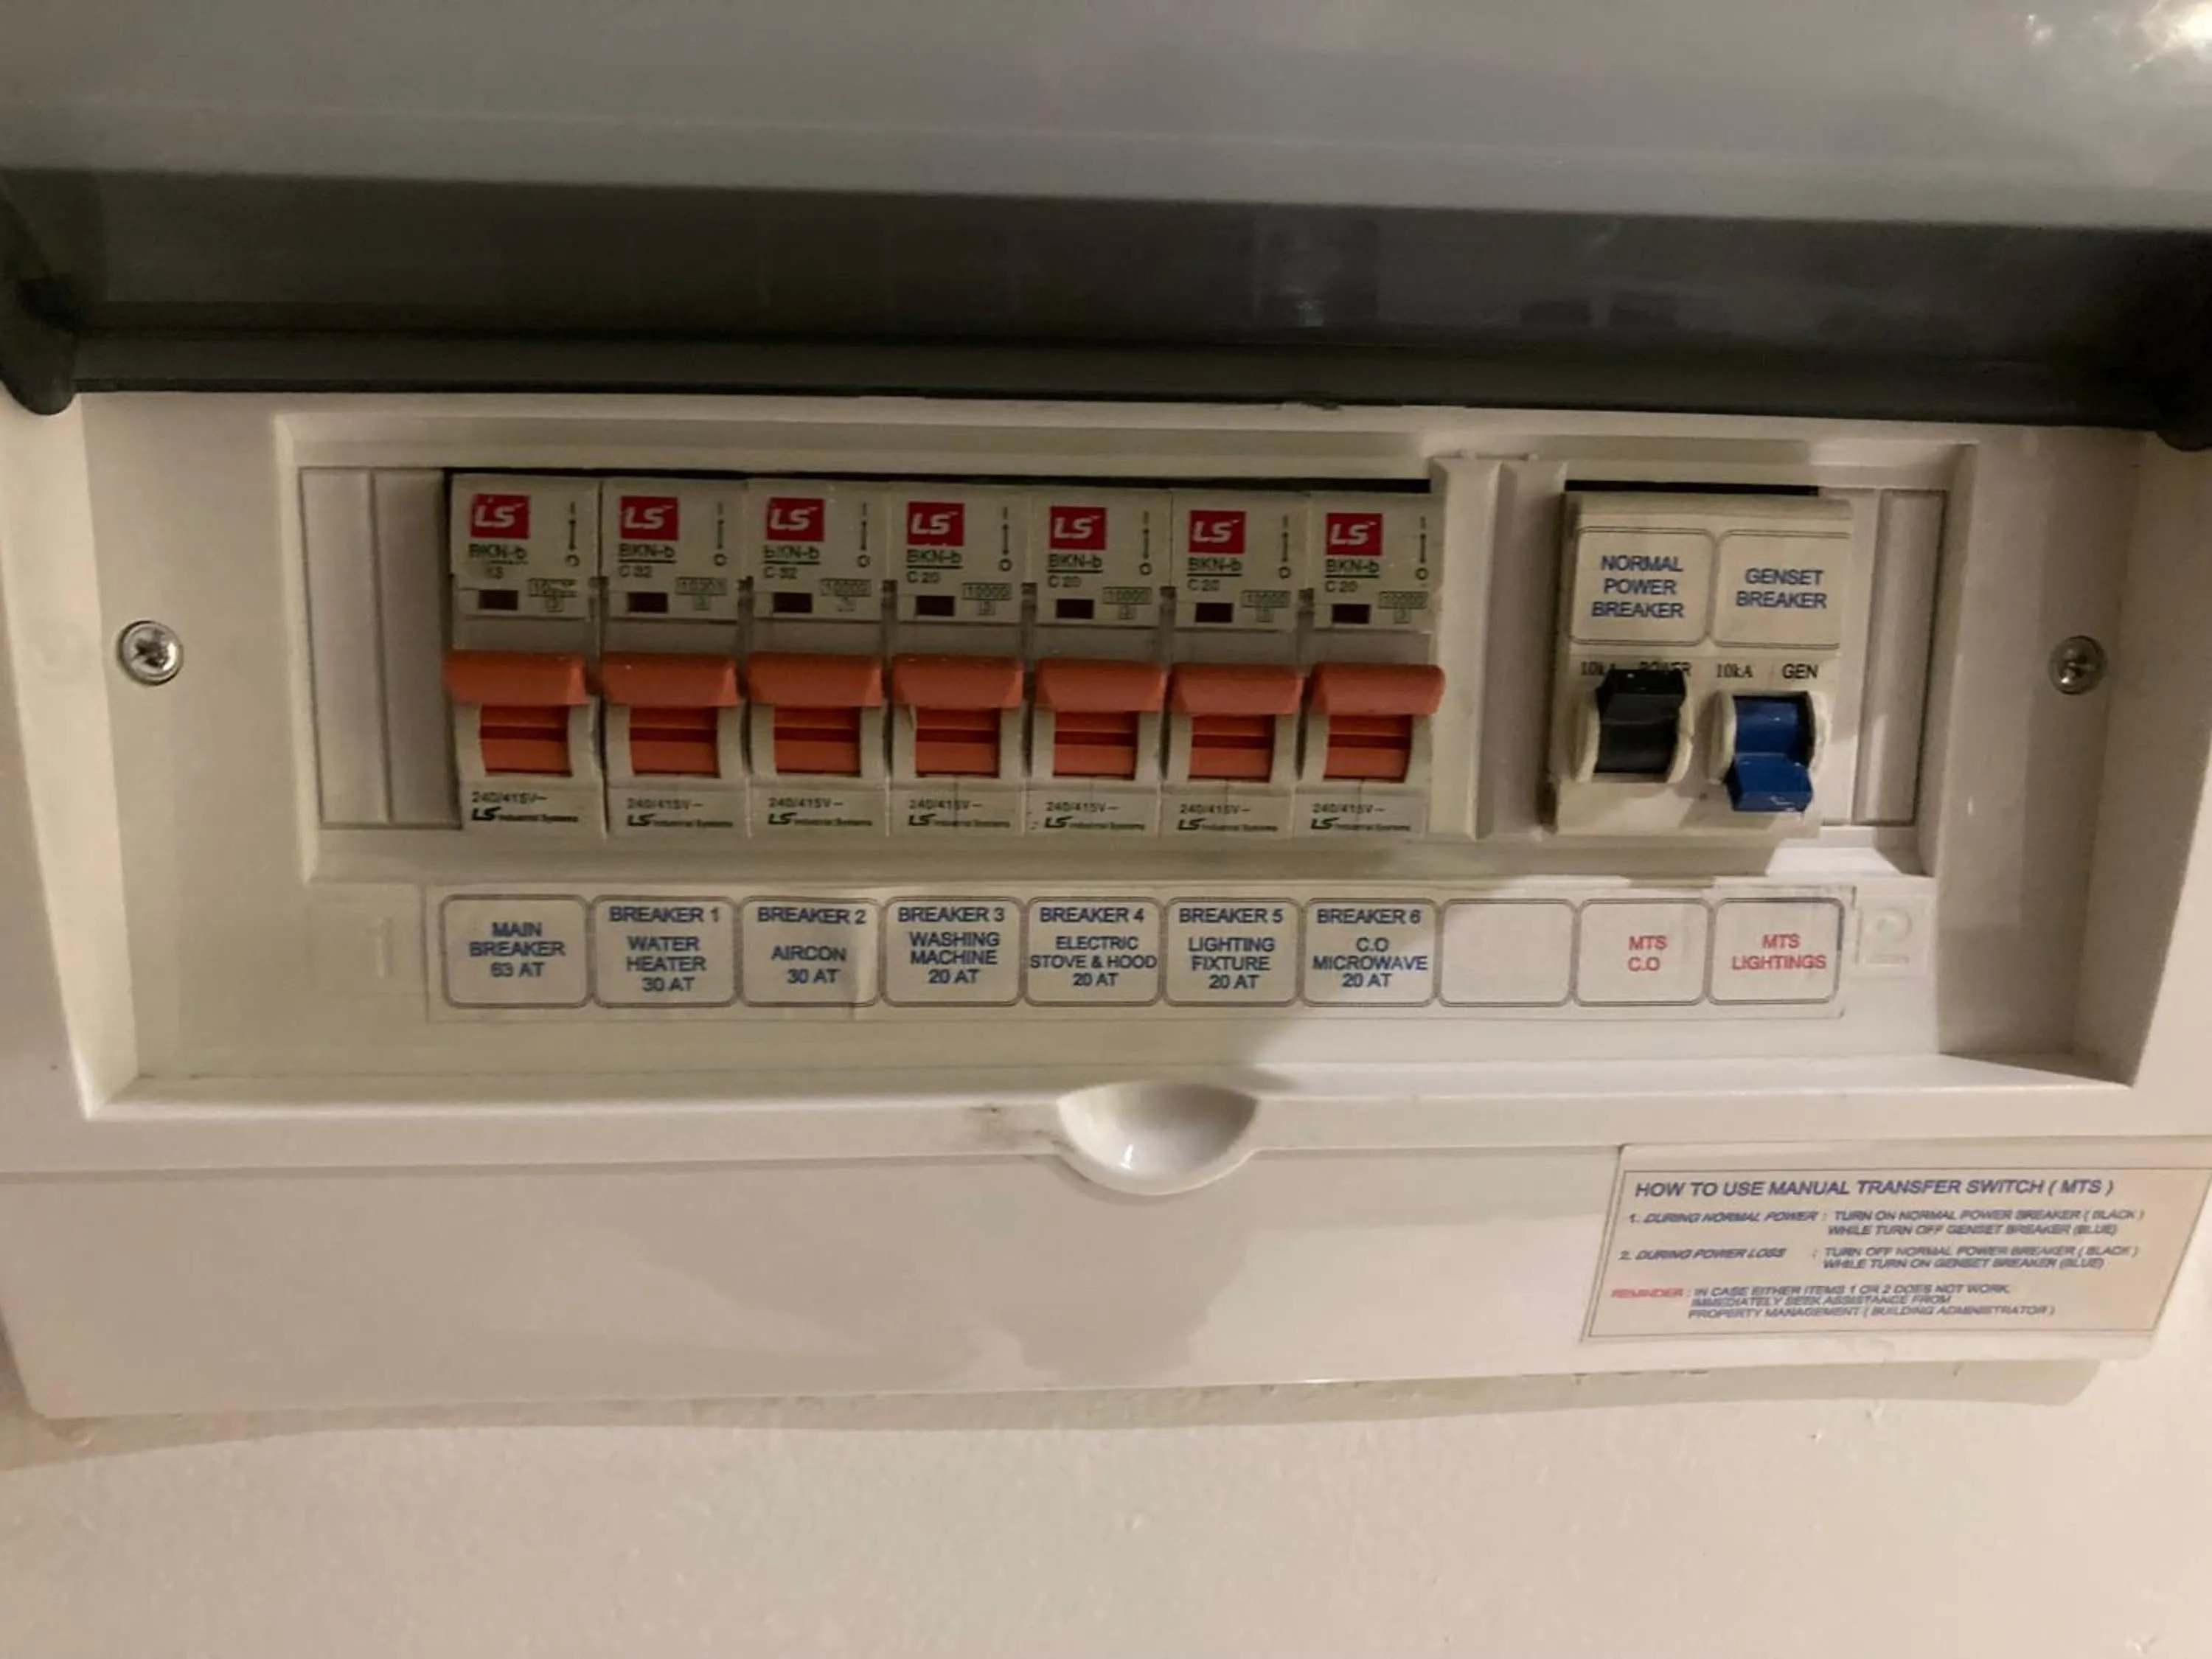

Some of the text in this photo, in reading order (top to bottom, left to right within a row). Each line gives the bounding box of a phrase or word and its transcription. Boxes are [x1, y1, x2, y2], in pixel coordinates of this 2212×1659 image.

[1048, 554, 1102, 568] BKN-b
[1601, 555, 1683, 572] NORMAL
[1746, 568, 1824, 585] GENSET
[1604, 578, 1676, 595] POWER
[1736, 591, 1827, 609] BREAKER
[1592, 601, 1684, 619] BREAKER
[1717, 664, 1818, 678] 10kA GEN
[471, 806, 502, 821] LS
[626, 813, 658, 827] LS
[767, 812, 798, 826] LS
[908, 813, 937, 827] LS
[1044, 815, 1074, 829] LS
[1178, 817, 1206, 830] LS
[1311, 816, 1340, 830] LS
[609, 907, 719, 922] BREAKER 1
[757, 908, 866, 924] BREAKER 2
[898, 907, 1005, 922] BREAKER 3
[1040, 908, 1144, 922] BREAKER 4
[1178, 908, 1283, 923] BREAKER 5
[1317, 909, 1422, 924] BREAKER 6
[493, 922, 541, 937] MAIN
[628, 936, 699, 952] WATER
[909, 931, 1000, 947] WASHING
[1056, 936, 1138, 951] ELECTRIC
[1189, 937, 1275, 953] LIGHTING
[1356, 937, 1389, 952] C.O
[1629, 935, 1667, 950] MTS
[1762, 933, 1800, 949] MTS
[470, 942, 566, 957] BREAKER
[771, 945, 846, 961] AIRCON
[626, 956, 706, 973] HEATER
[911, 950, 997, 965] MACHINE
[1030, 954, 1158, 970] STOVE & HOOD
[1192, 956, 1270, 972] FIXTURE
[1312, 956, 1427, 971] MICROWAVE
[1628, 957, 1660, 971] C.O
[1732, 956, 1826, 970] LIGHTINGS
[491, 962, 545, 978] 63 AT
[787, 969, 840, 984] 30 AT
[928, 969, 979, 984] 20 AT
[642, 977, 695, 992] 30 AT
[1073, 972, 1119, 987] 20 AT
[1208, 974, 1259, 990] 20 AT
[1342, 973, 1392, 988] 20 AT
[1635, 1179, 2101, 1197] HOW TO USE MANUAL TRANSFER SWITCH MTS
[1644, 1212, 1700, 1223] DURING
[1702, 1211, 1759, 1222] NORMAL
[1764, 1211, 1819, 1222] POWER
[1834, 1211, 1873, 1221] TURN
[1899, 1210, 1956, 1221] NORMAL
[1961, 1210, 2012, 1220] POWER
[2016, 1210, 2081, 1220] BREAKER
[2093, 1210, 2136, 1220] BLACK
[1829, 1224, 2118, 1236] WHILE TURN OFF GENSET BREAKER (BLUE)
[1635, 1248, 1691, 1260] DURING
[1694, 1248, 1747, 1259] POWER
[1747, 1248, 1786, 1258] LOSS
[1825, 1247, 1860, 1258] TURN
[1865, 1247, 1893, 1256] OFF
[1896, 1246, 1950, 1256] NORMAL
[1958, 1246, 2007, 1256] POWER
[2011, 1246, 2074, 1256] BREAKER
[2087, 1246, 2129, 1256] BLACK
[1823, 1259, 1866, 1269] WHILE
[1871, 1259, 1906, 1269] TURN
[1935, 1258, 1988, 1268] GENSET
[1993, 1258, 2057, 1268] BREAKER
[2059, 1257, 2104, 1270] (BLUE)
[1612, 1288, 1683, 1298] REMINDER
[1709, 1287, 1748, 1296] CASE
[1751, 1287, 1800, 1295] EITHER
[1803, 1286, 1843, 1295] ITEMS
[1893, 1284, 1932, 1294] DOES
[1935, 1284, 1964, 1294] NOT
